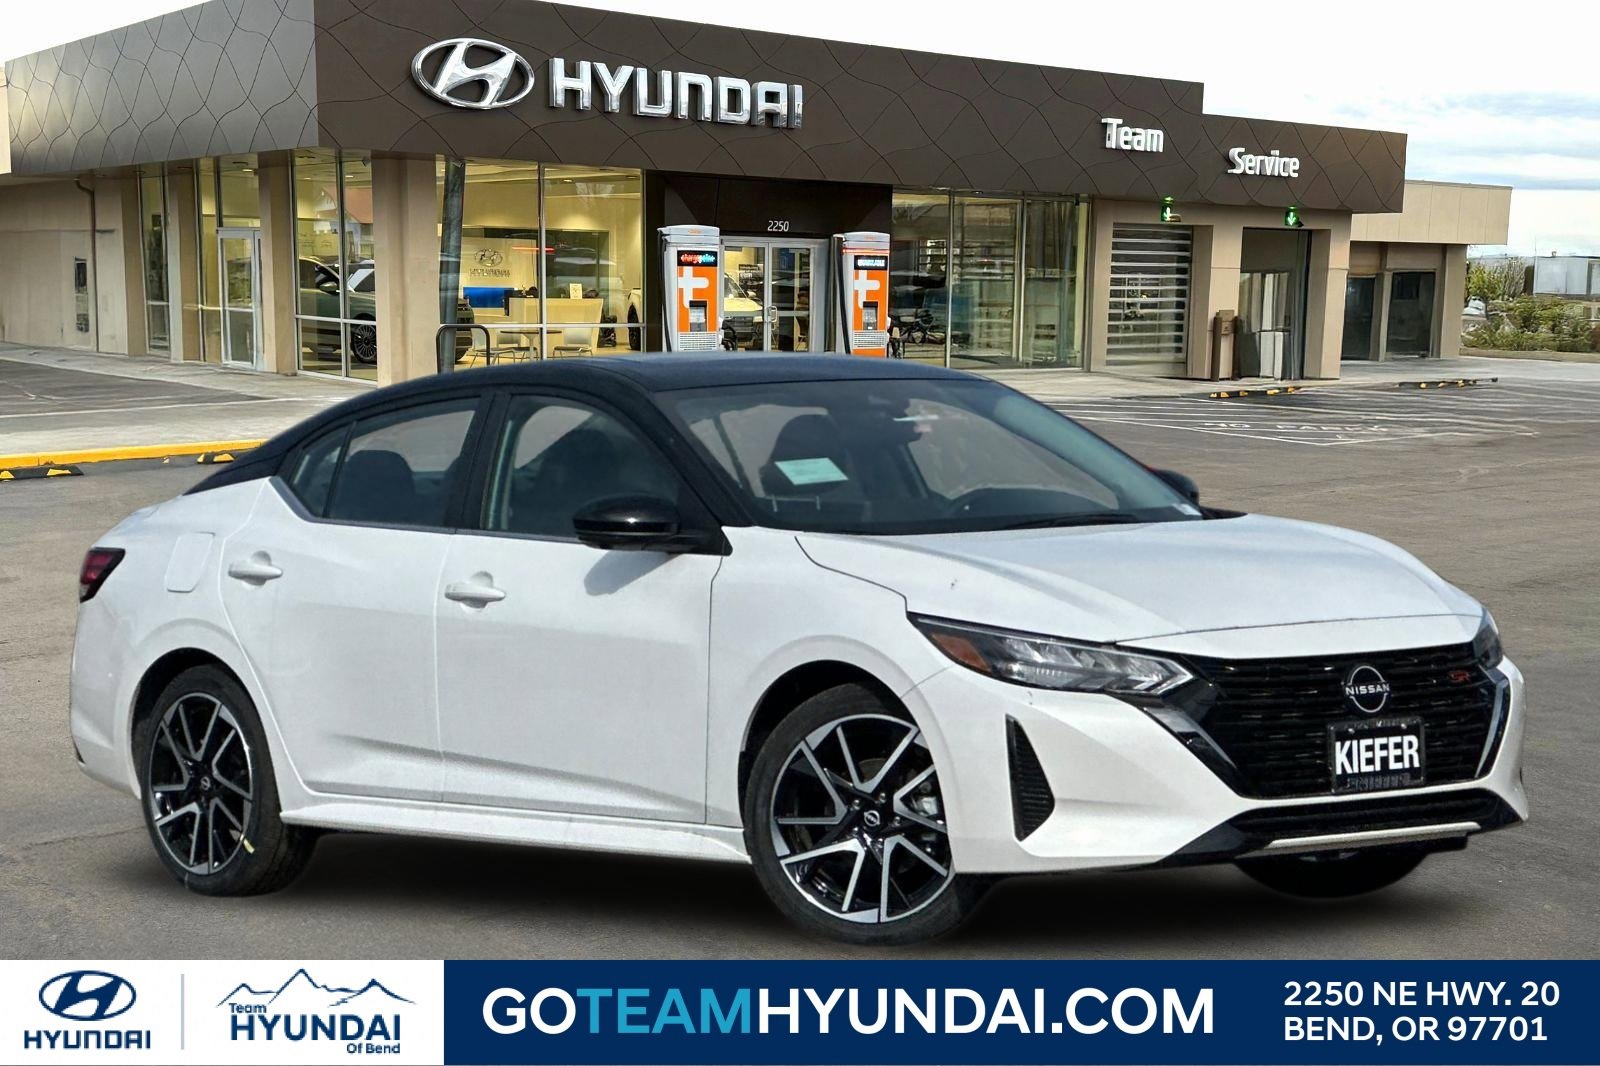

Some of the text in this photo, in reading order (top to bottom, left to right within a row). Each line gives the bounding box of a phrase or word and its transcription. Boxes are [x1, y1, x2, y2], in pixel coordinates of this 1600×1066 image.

[548, 57, 804, 129] HYUNDAI
[1101, 117, 1164, 153] Team
[1227, 147, 1300, 178] Service
[767, 220, 790, 233] 2250
[1345, 683, 1391, 696] NISSAN
[1334, 734, 1421, 775] KIEFER
